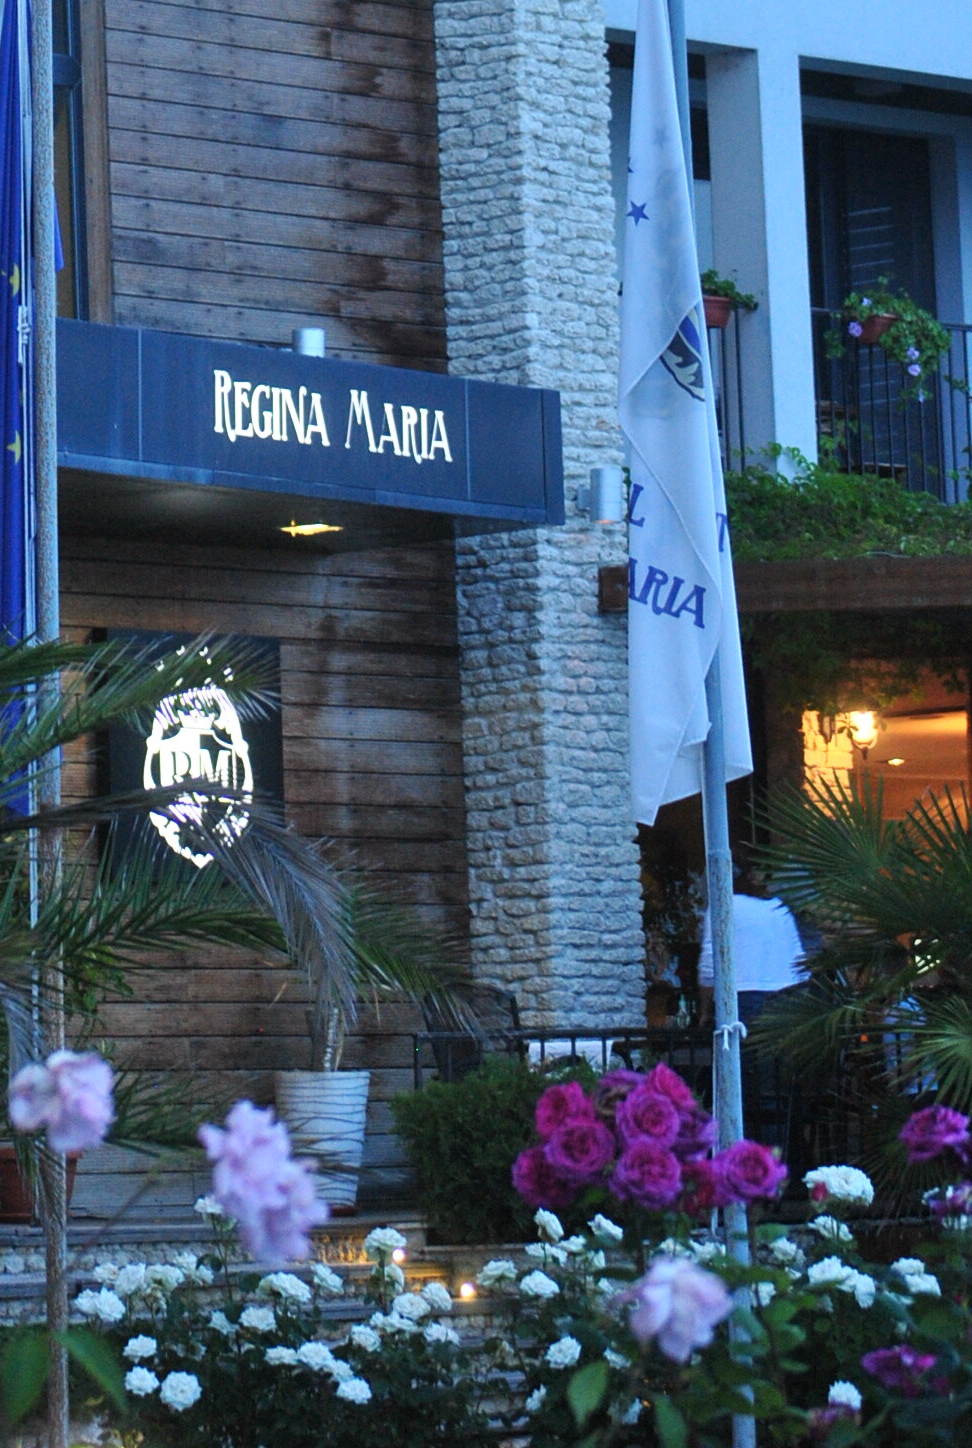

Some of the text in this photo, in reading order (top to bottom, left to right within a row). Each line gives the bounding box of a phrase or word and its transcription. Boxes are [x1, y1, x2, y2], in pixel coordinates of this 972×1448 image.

[213, 368, 454, 464] REGINA MARIA
[628, 556, 707, 630] ARIA
